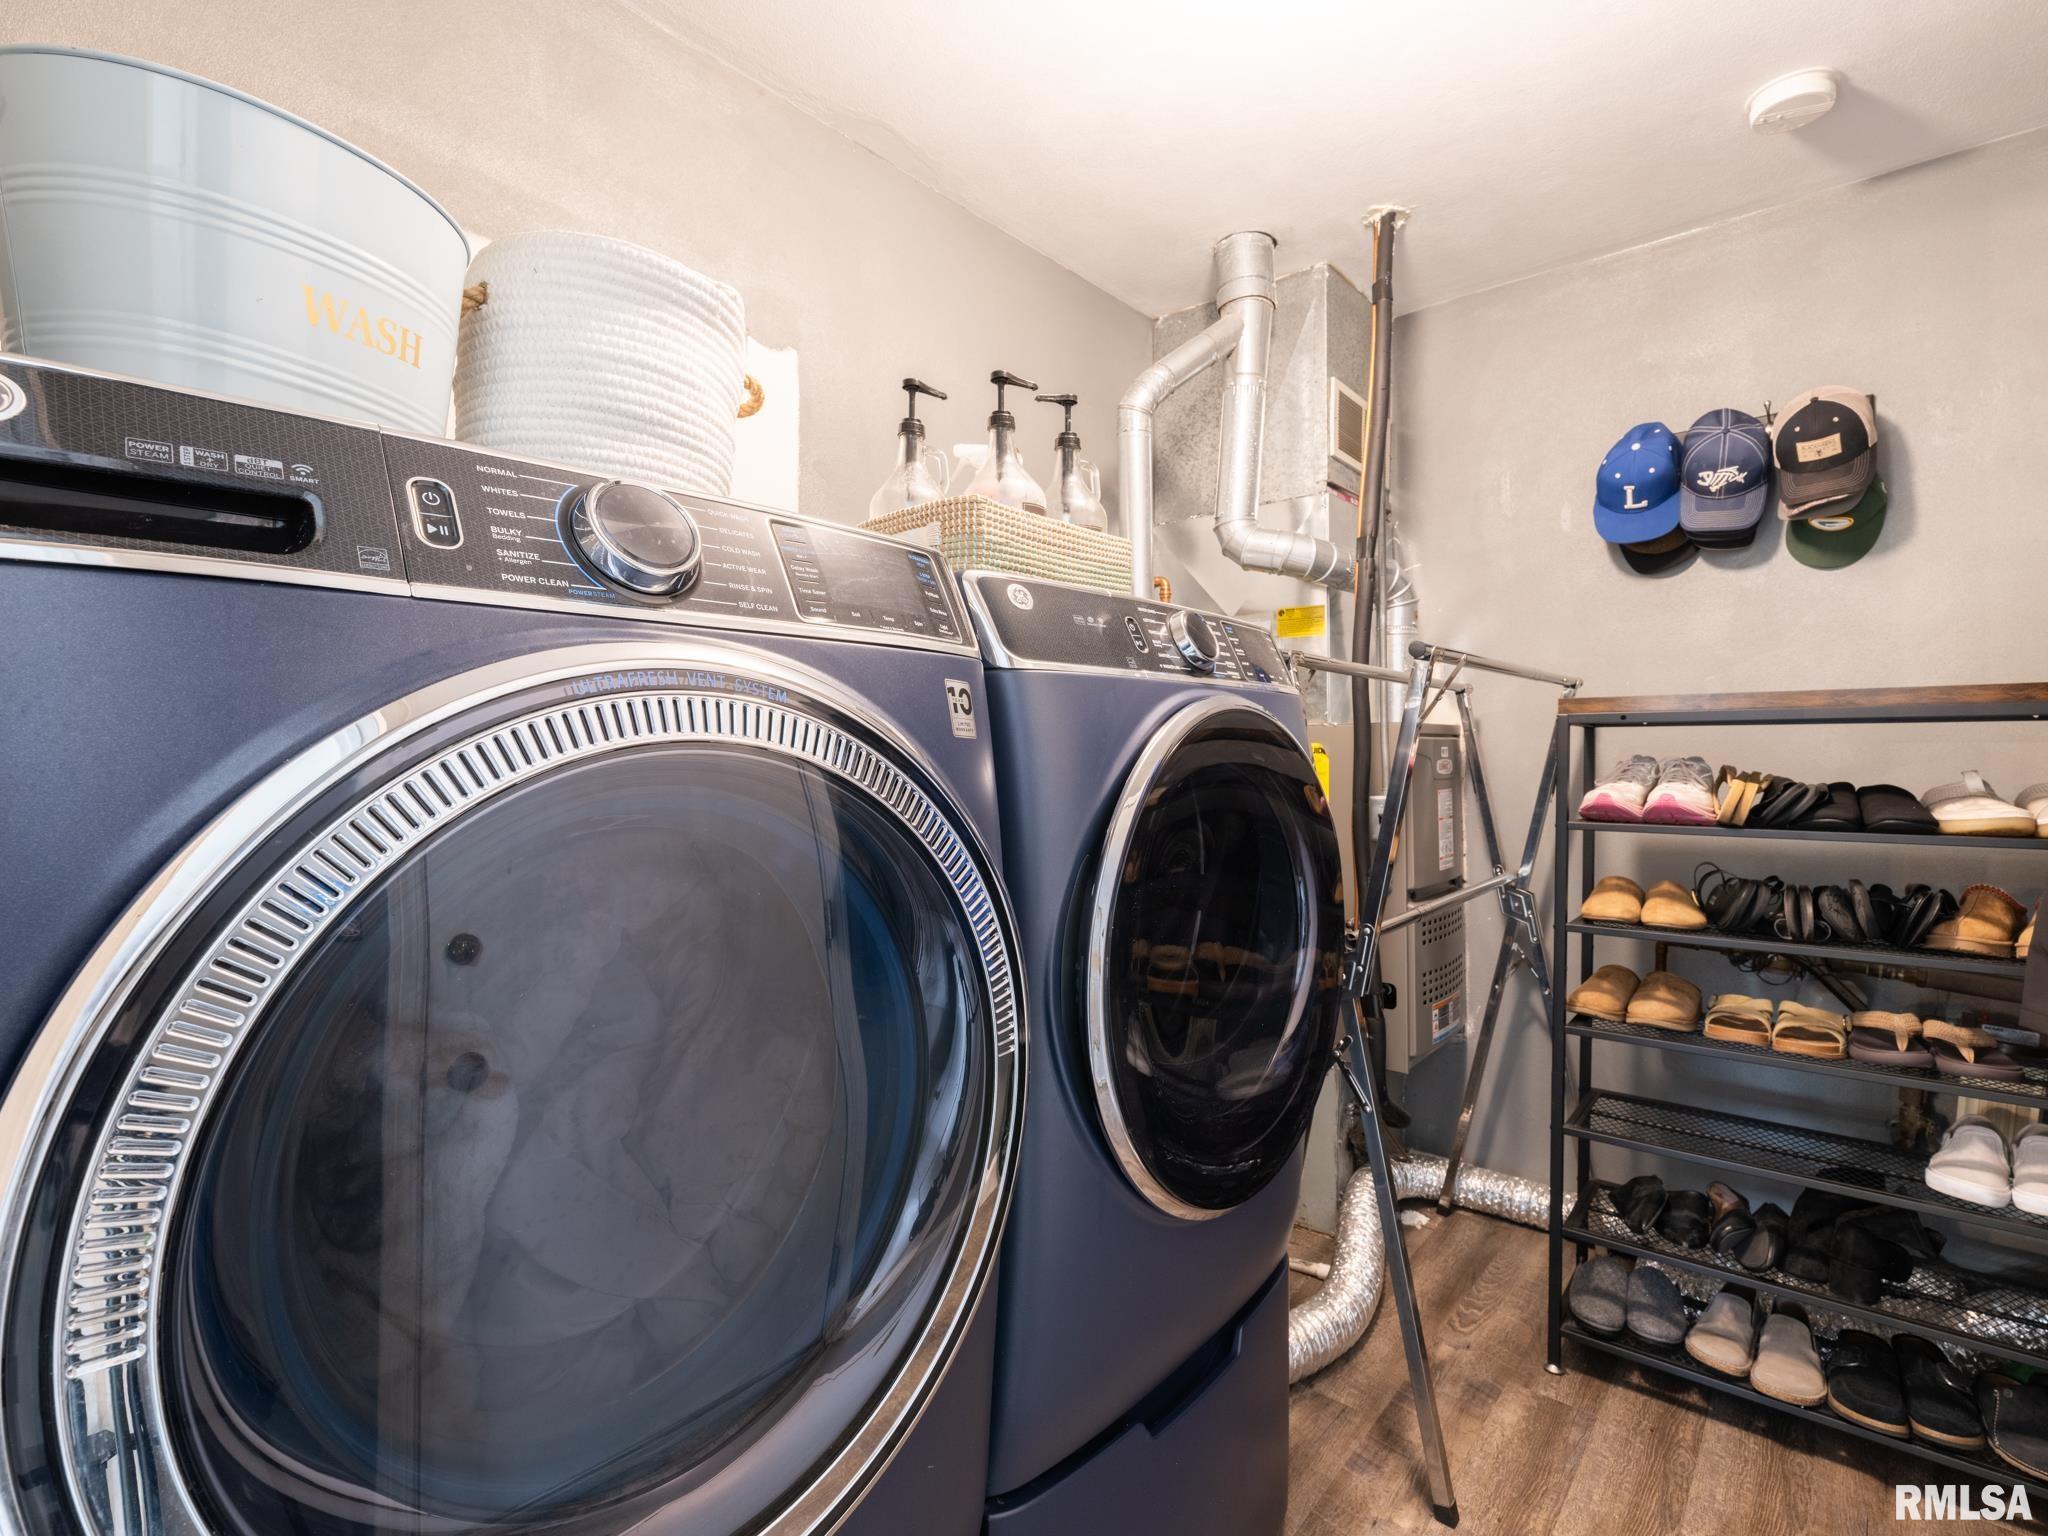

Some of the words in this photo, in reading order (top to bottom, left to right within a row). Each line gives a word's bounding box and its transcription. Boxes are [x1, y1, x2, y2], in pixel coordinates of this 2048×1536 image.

[300, 283, 423, 369] WASH
[128, 440, 170, 452] POWER
[129, 448, 169, 460] STEAM
[195, 449, 225, 460] WASH
[200, 461, 219, 469] DRY
[244, 463, 271, 472] QUIET
[238, 467, 281, 479] CONTROL
[476, 465, 518, 478] NORMAL
[289, 475, 320, 484] SMART
[481, 485, 519, 497] WHITES
[1623, 485, 1648, 509] L
[487, 507, 527, 519] TOWELS
[490, 525, 522, 536] BULKY
[719, 527, 755, 539] DELICATES
[492, 533, 522, 543] Bedding
[496, 548, 541, 560] SANITIZE
[721, 544, 742, 554] COLD
[742, 547, 761, 558] WASH
[504, 557, 533, 566] Allergen
[722, 562, 747, 573] ACTIVE
[748, 566, 767, 576] WEAR
[501, 573, 537, 584] POWER
[538, 577, 570, 588] CLEAN
[728, 582, 750, 592] RINSE
[756, 586, 773, 595] SPIN
[738, 601, 756, 611] SELF
[756, 603, 779, 613] CLEAN
[687, 671, 726, 688] VENT
[734, 678, 788, 704] SYSTEM
[946, 686, 973, 716] 10
